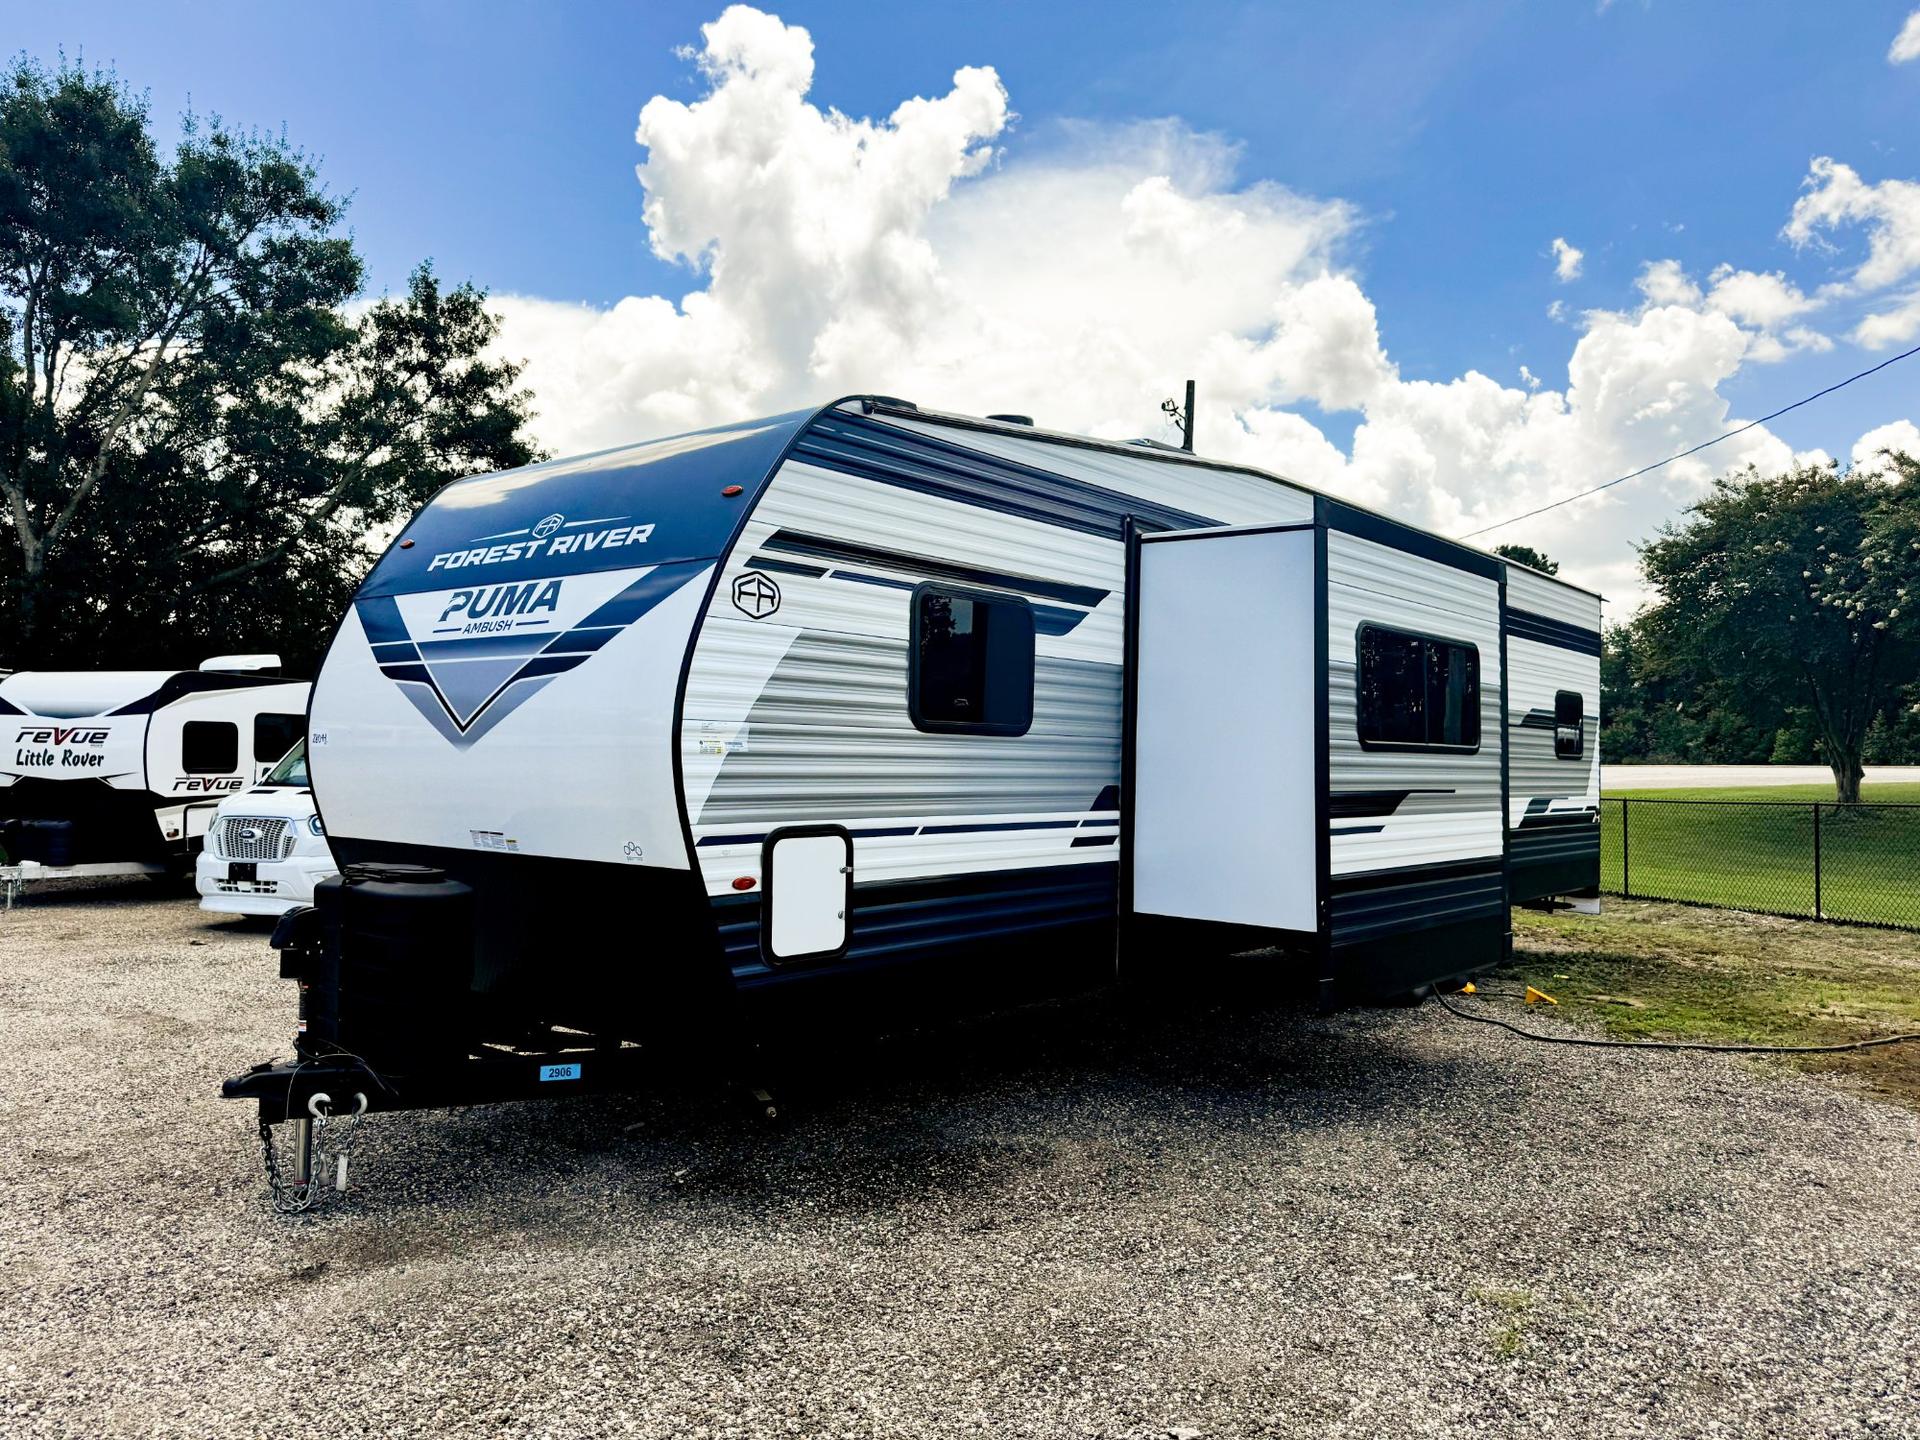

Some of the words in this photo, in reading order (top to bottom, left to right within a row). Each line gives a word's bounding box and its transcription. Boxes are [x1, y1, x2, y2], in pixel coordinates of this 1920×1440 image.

[427, 539, 547, 572] FOREST
[547, 524, 656, 556] RIVER
[438, 579, 564, 622] PUMA
[462, 620, 514, 634] AMBUSH
[16, 748, 54, 766] Little
[61, 748, 105, 767] Rover
[548, 1067, 572, 1078] 2906
